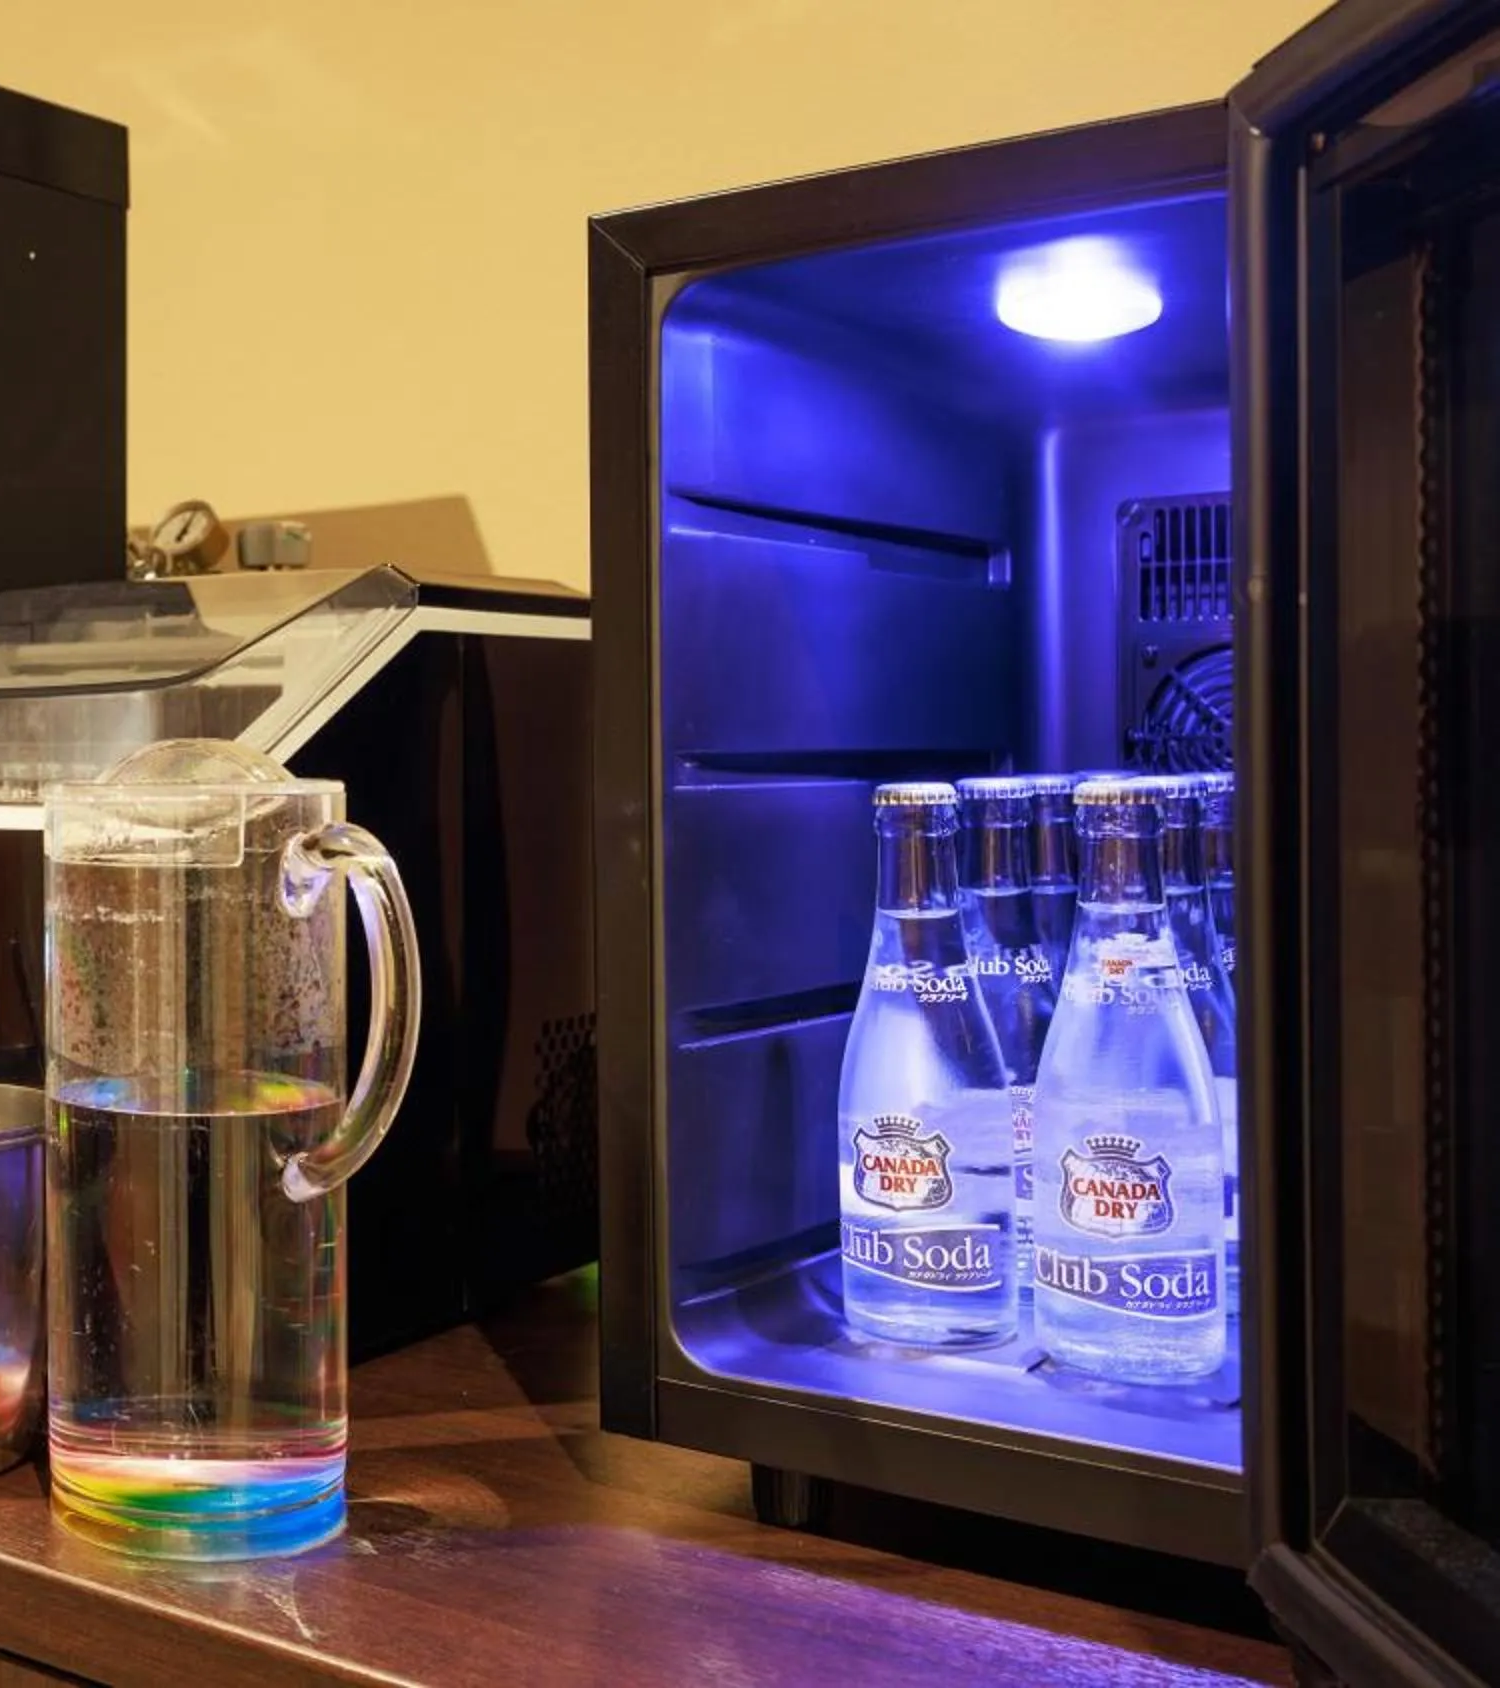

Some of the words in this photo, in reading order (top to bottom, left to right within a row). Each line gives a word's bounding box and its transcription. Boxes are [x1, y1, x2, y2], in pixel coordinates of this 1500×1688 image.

[913, 973, 968, 993] Soda
[862, 1153, 940, 1176] CANADA
[880, 1175, 918, 1193] DRY
[1073, 1177, 1161, 1201] CANADA
[1094, 1199, 1138, 1219] DRY
[903, 1234, 992, 1271] Soda
[1036, 1247, 1108, 1295] Club
[1119, 1258, 1209, 1299] Soda
